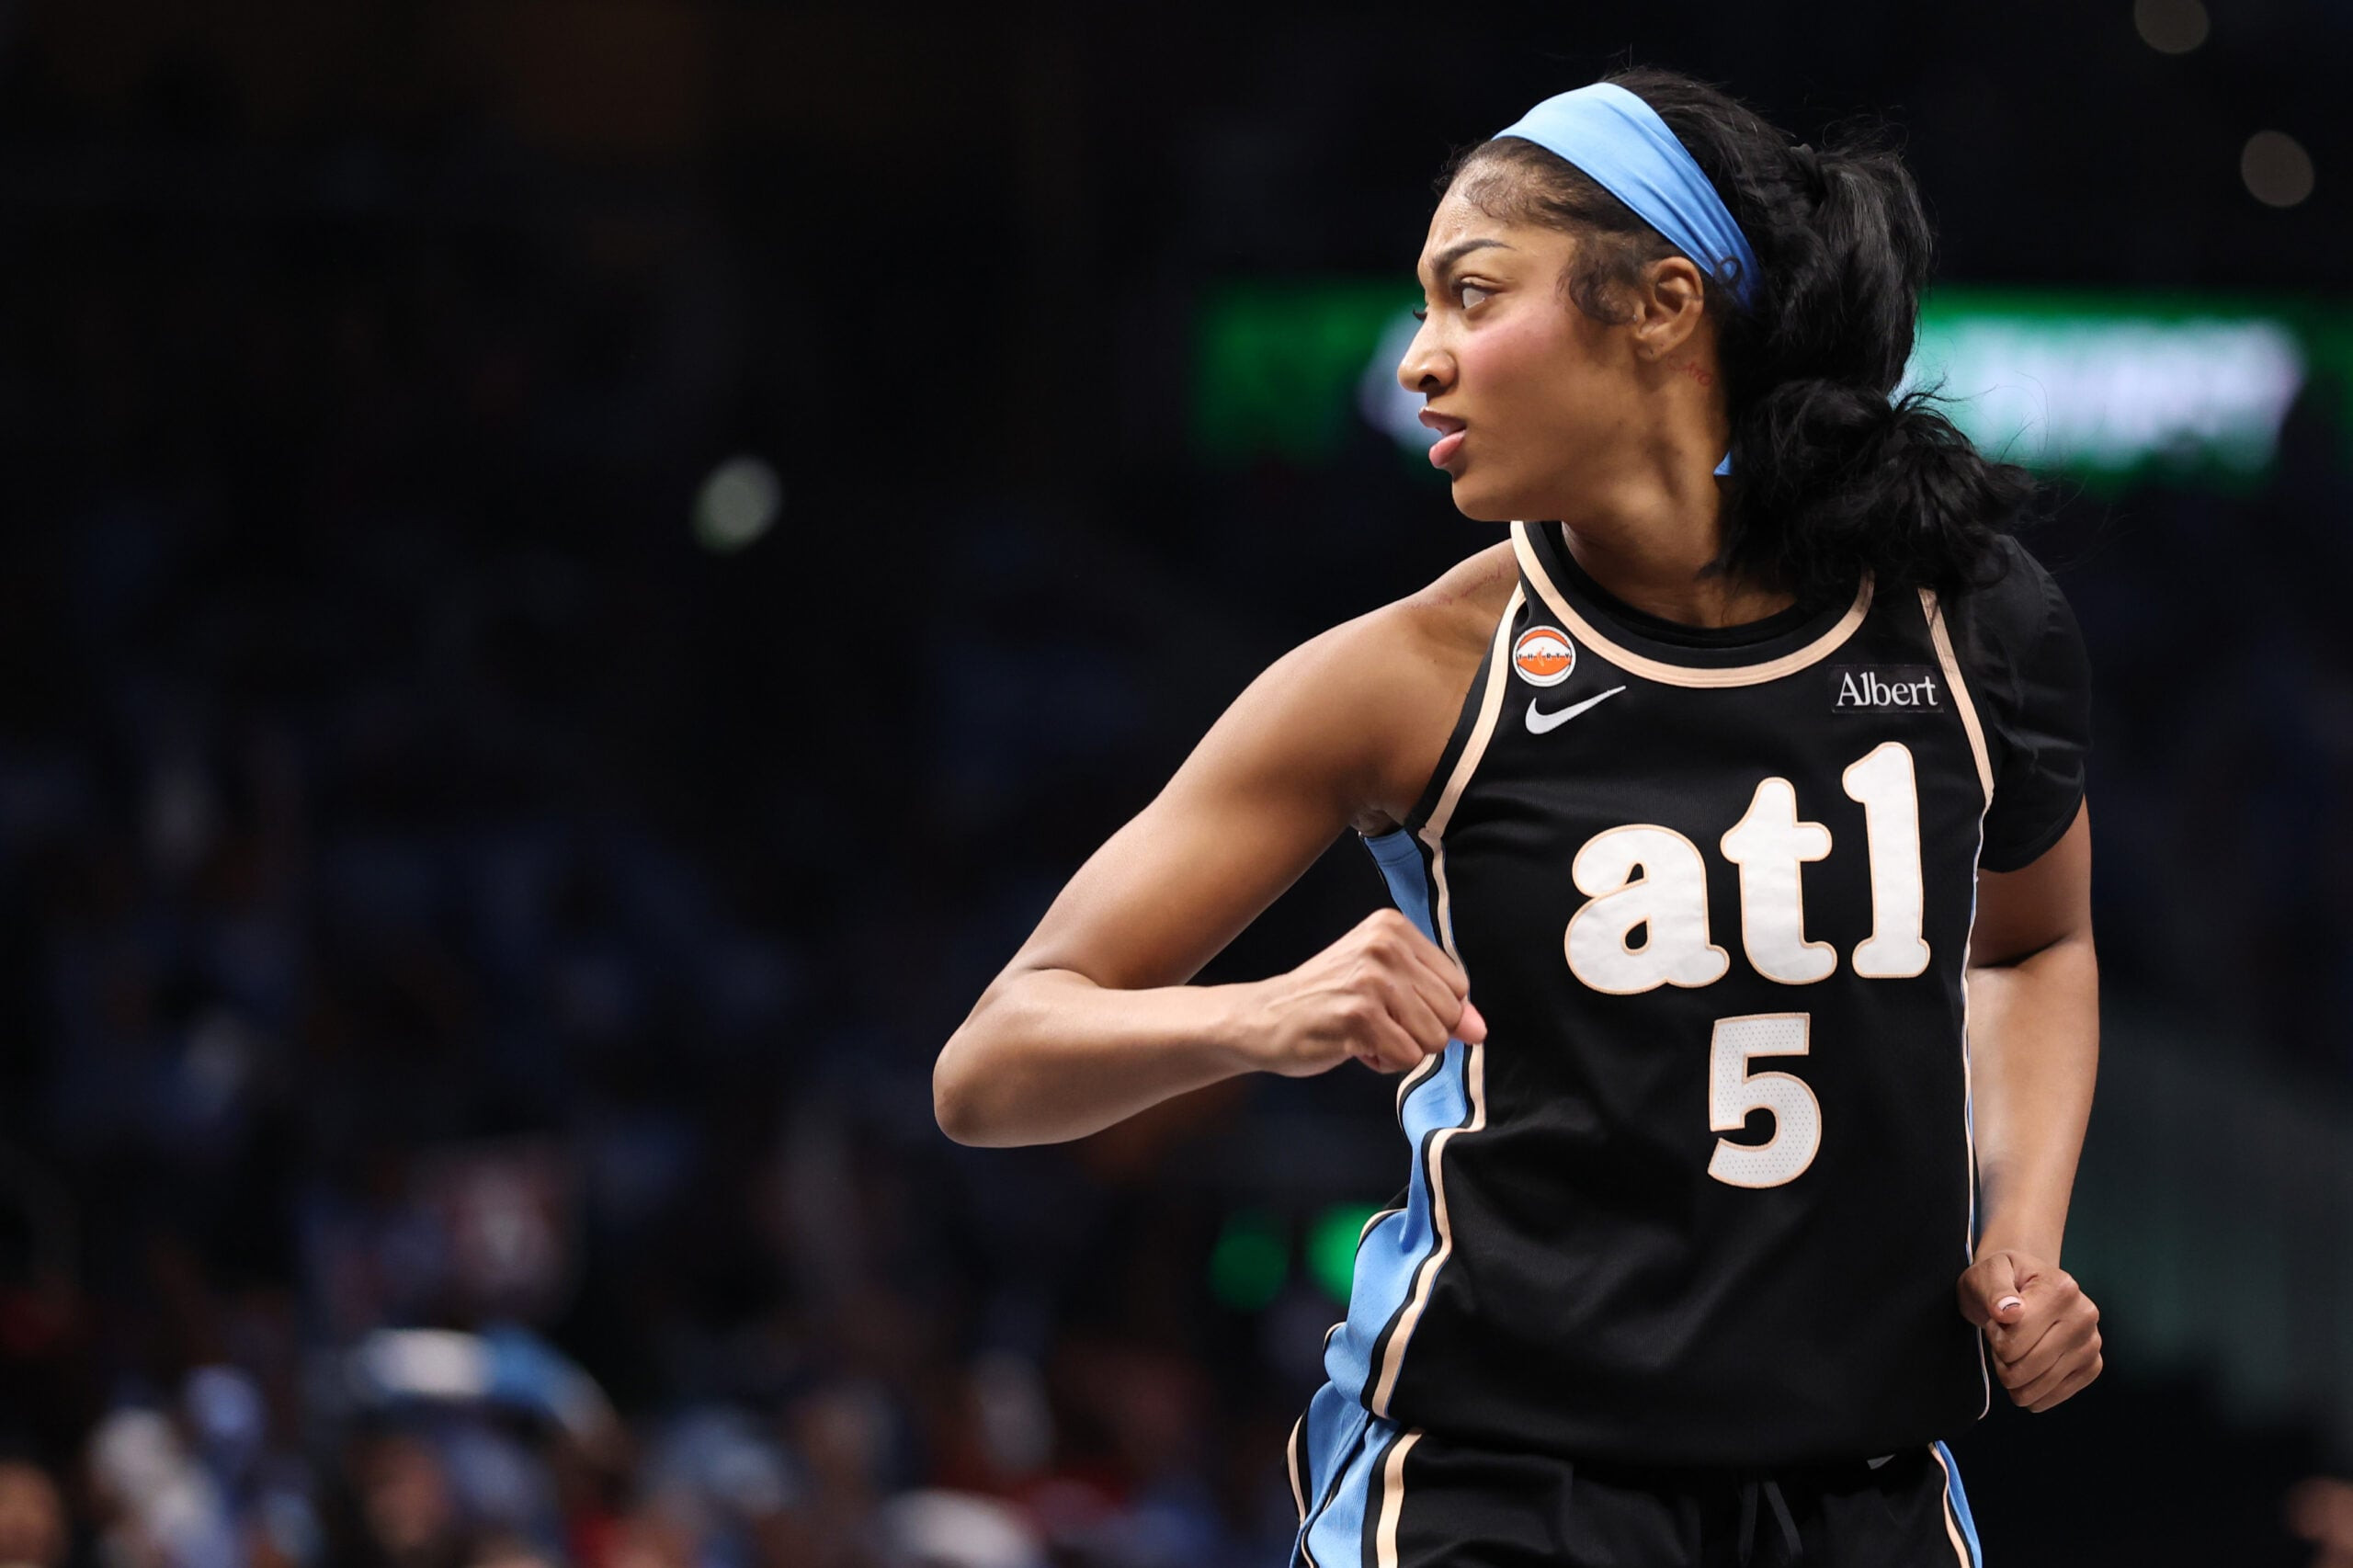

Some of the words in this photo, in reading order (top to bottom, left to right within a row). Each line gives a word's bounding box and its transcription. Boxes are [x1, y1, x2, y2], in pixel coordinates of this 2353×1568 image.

[1836, 671, 1938, 707] Albert
[1563, 741, 1931, 995] atl
[1707, 1012, 1823, 1189] 5
